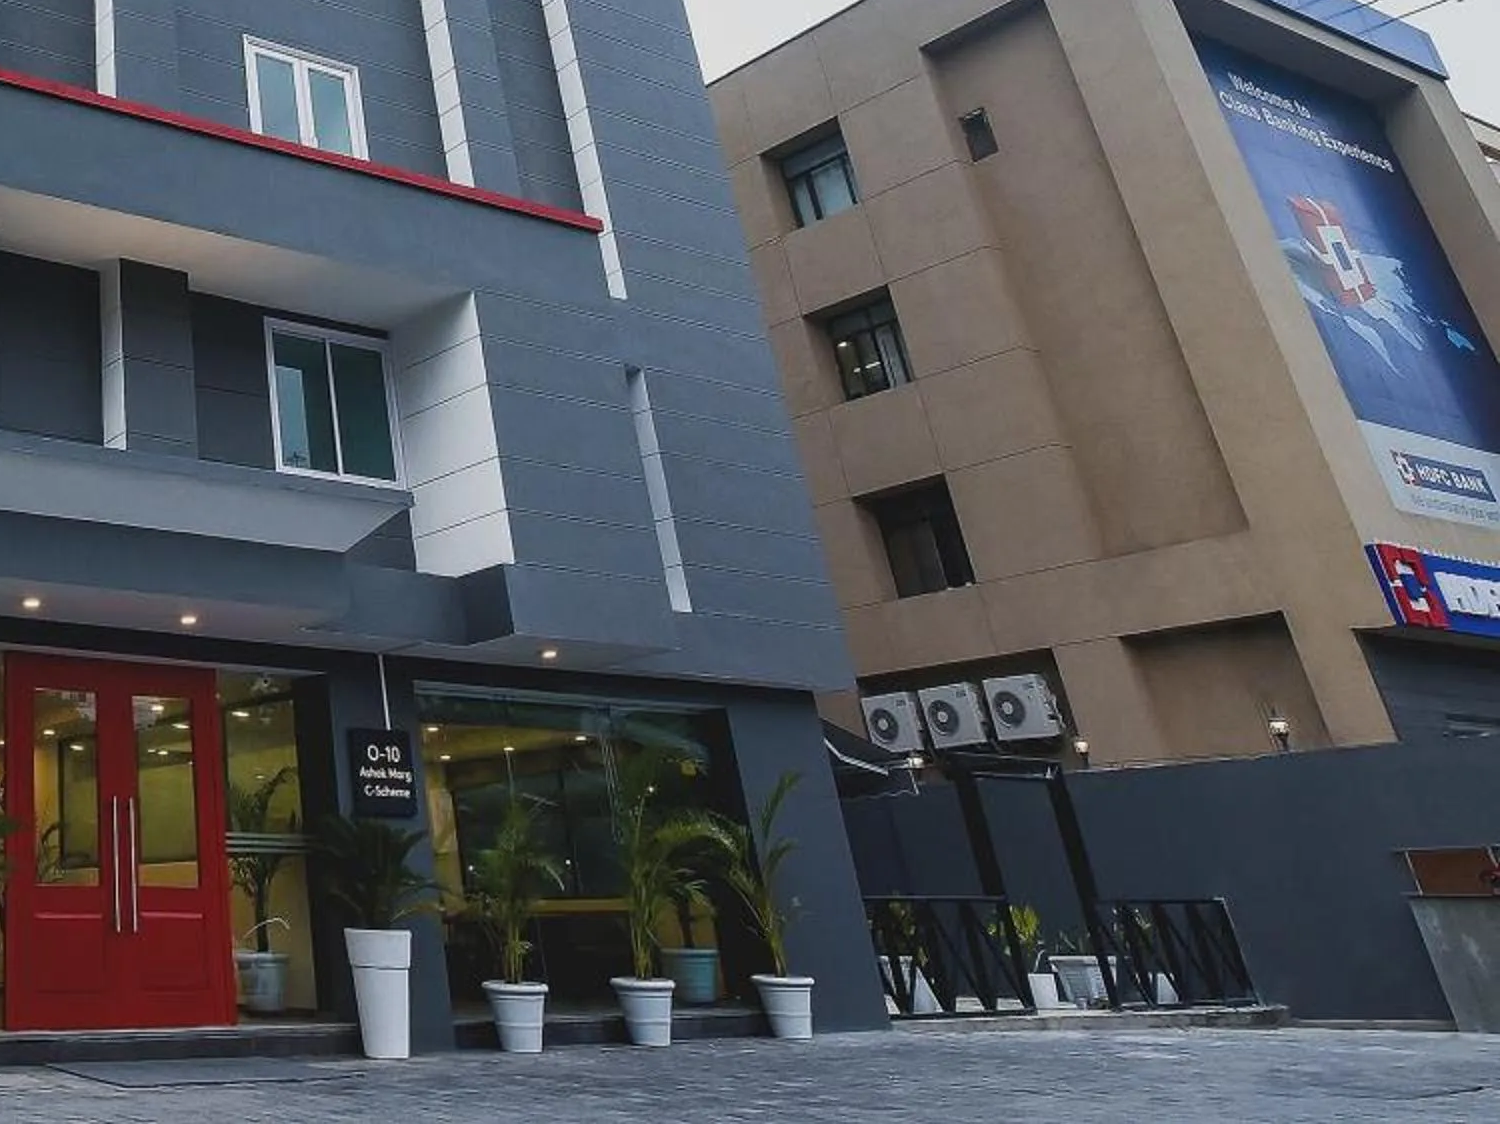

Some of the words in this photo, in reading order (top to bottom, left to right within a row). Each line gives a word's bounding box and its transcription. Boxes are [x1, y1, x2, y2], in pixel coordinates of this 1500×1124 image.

[1228, 71, 1295, 113] Welcome
[1294, 98, 1312, 119] to
[1261, 107, 1322, 146] Banking
[1319, 130, 1395, 173] Experience
[1415, 463, 1452, 487] HDFC
[1450, 471, 1490, 495] BANK
[359, 765, 387, 779] Ashok
[387, 767, 412, 783] Marg
[364, 784, 411, 799] C-Scheme
